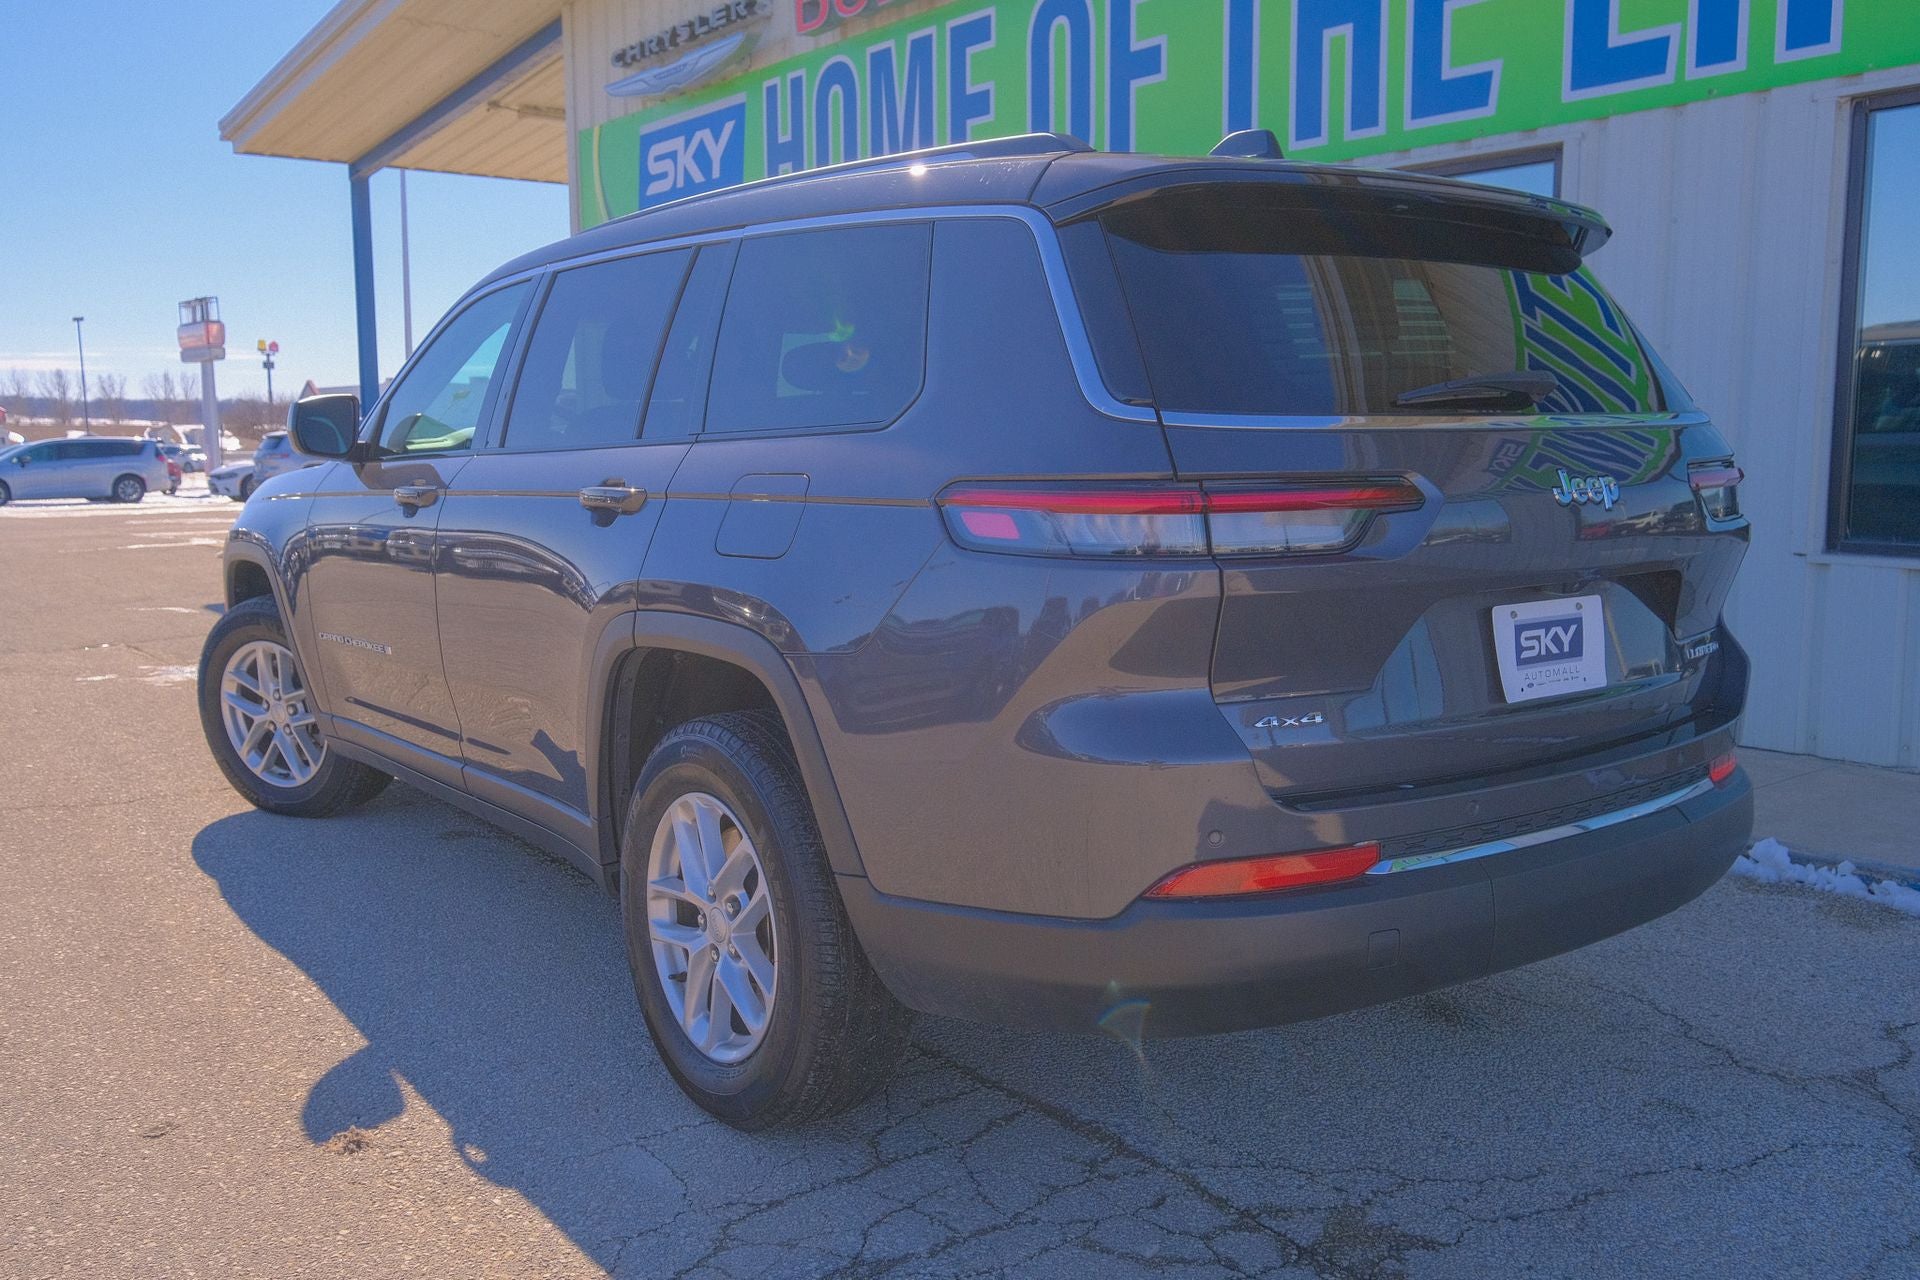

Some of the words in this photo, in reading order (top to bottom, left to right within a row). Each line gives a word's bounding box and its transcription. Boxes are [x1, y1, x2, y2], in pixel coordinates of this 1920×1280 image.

[610, 1, 750, 68] CHRYSLER
[763, 7, 996, 178] HOME
[1027, 0, 1167, 152] OF
[645, 119, 736, 197] SKY
[1552, 468, 1620, 511] Jeep
[1520, 623, 1578, 659] SKY
[1524, 664, 1580, 681] AUTOMALL
[1253, 710, 1324, 729] 4x4
